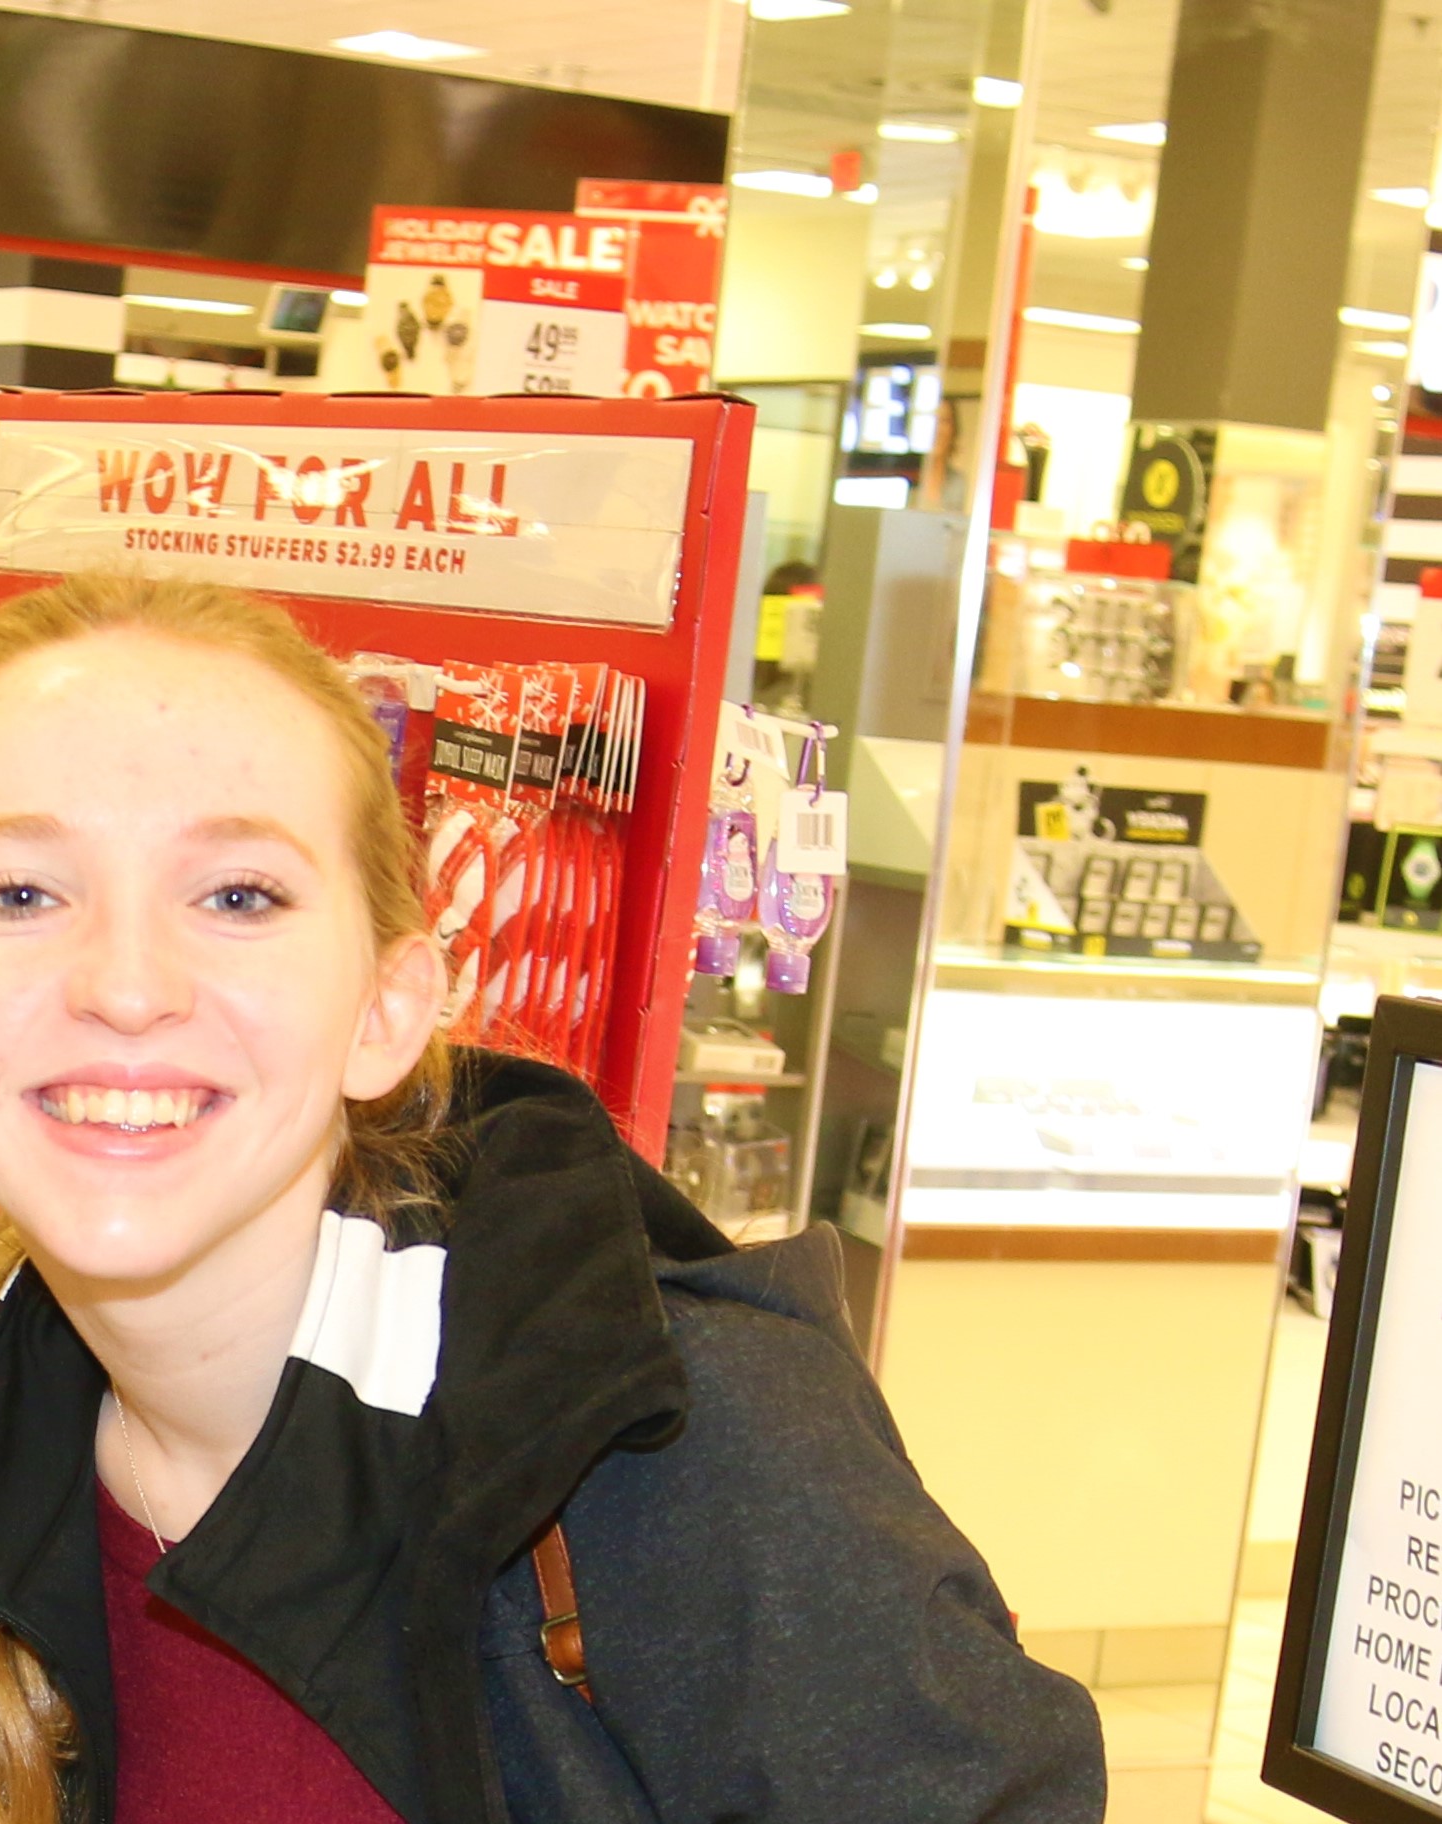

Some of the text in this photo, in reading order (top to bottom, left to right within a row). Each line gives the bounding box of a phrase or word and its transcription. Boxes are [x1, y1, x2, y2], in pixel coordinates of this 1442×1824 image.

[379, 240, 486, 265] JEWELRY
[383, 217, 487, 242] HOLIDAY
[486, 222, 626, 272] SALE
[530, 277, 580, 300] SALE
[95, 449, 521, 538] WOW FOR ALL
[124, 527, 467, 575] STOCKING STUFFERS $2.99 EACH
[1366, 1574, 1442, 1629] PROC
[1353, 1623, 1434, 1682] HOME
